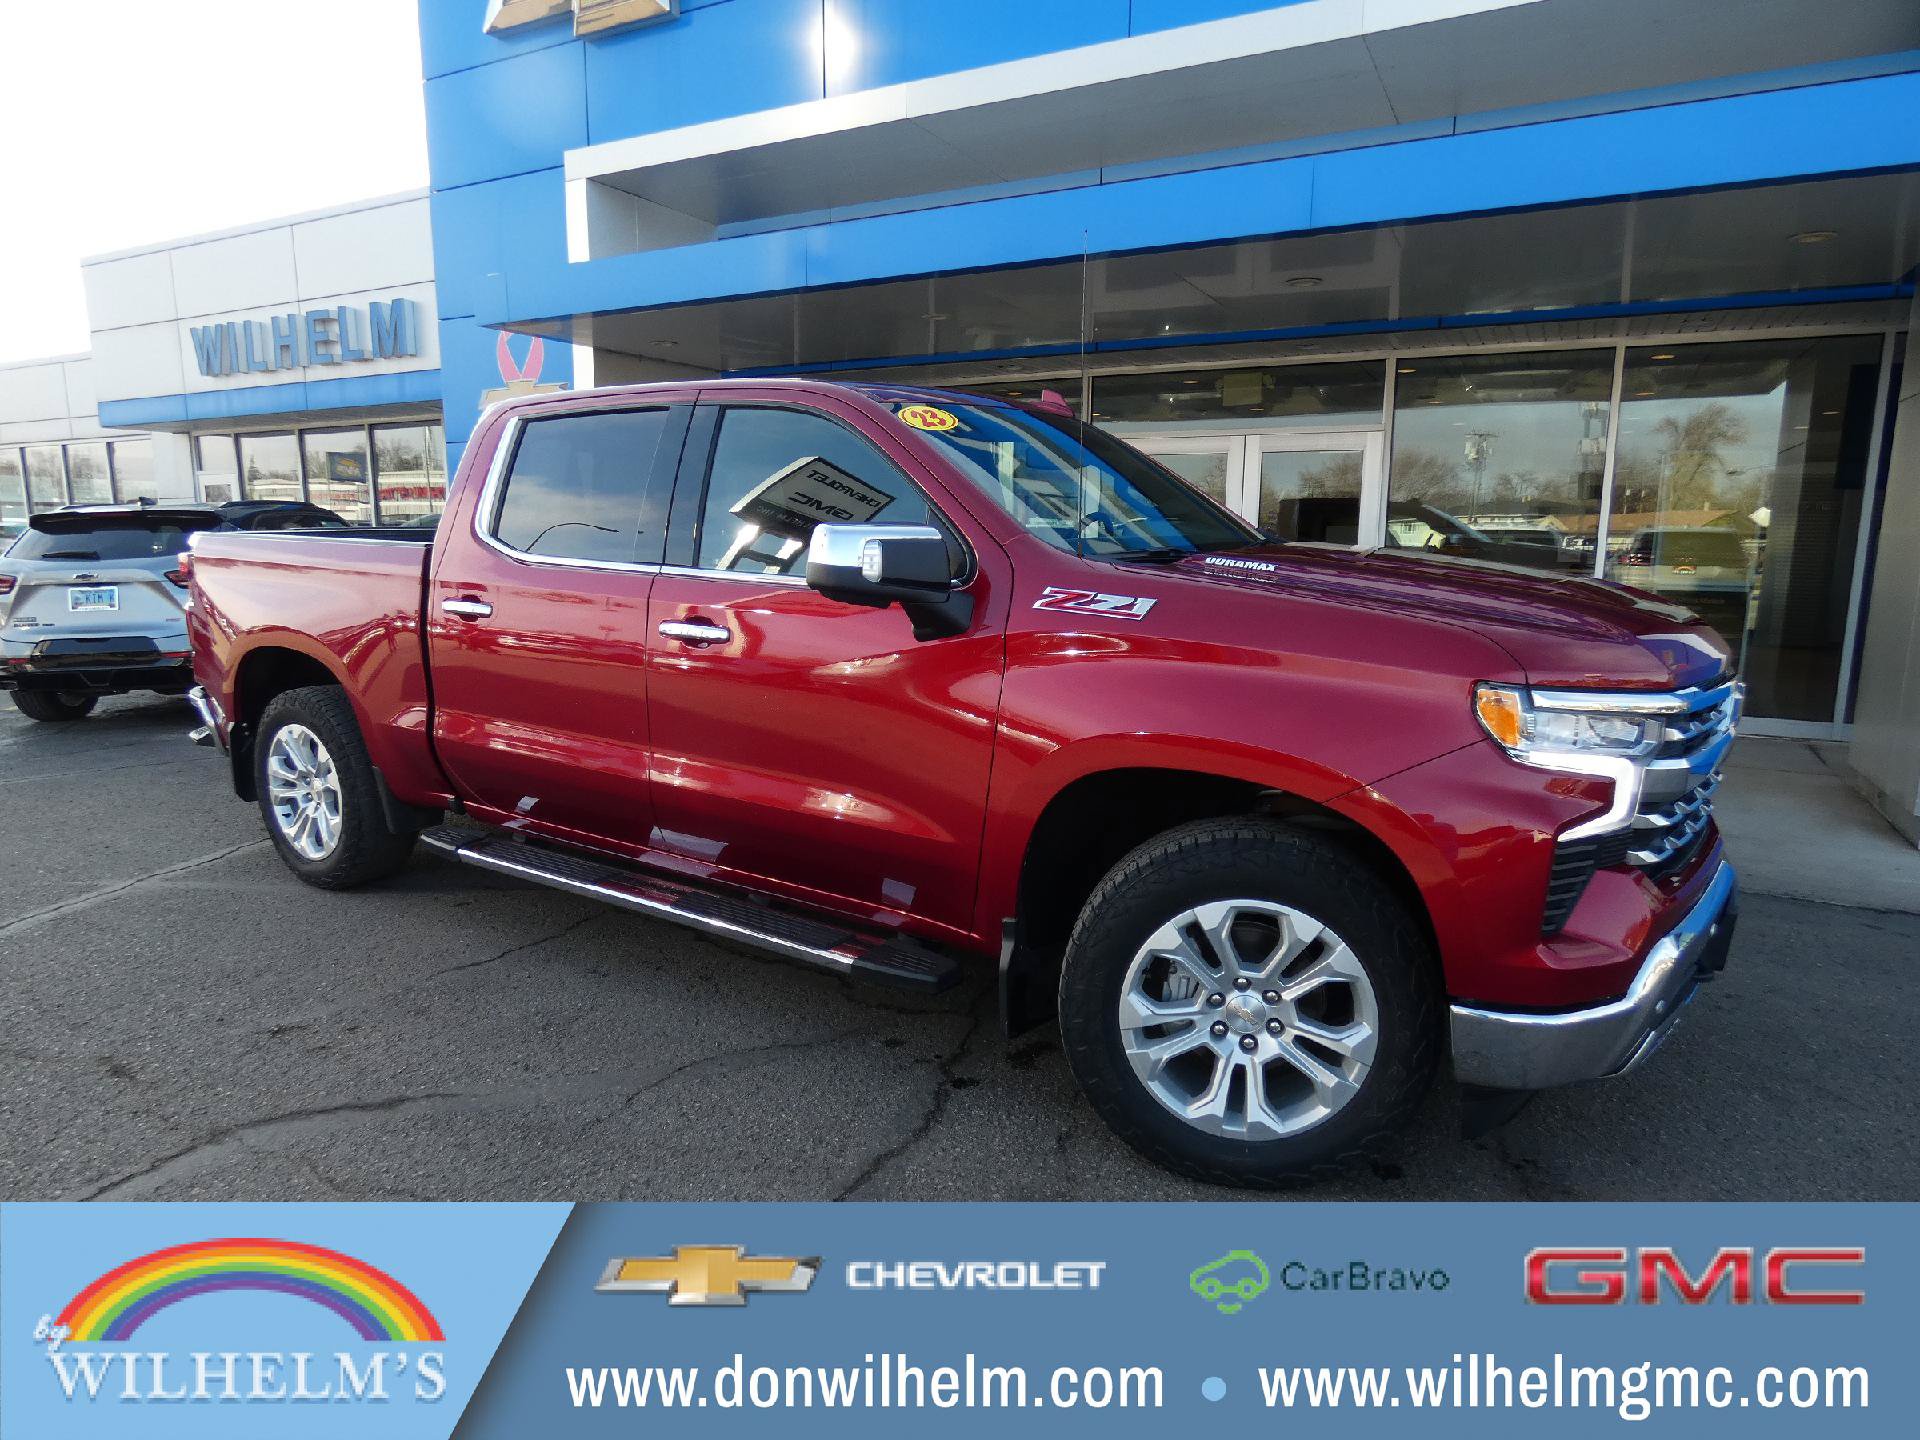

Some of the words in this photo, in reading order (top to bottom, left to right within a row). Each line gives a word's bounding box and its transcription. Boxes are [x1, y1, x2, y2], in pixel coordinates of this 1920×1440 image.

[190, 298, 417, 377] WILHELM
[910, 409, 947, 428] 23
[1205, 556, 1278, 572] DURAMAX
[1033, 586, 1157, 620] Z71
